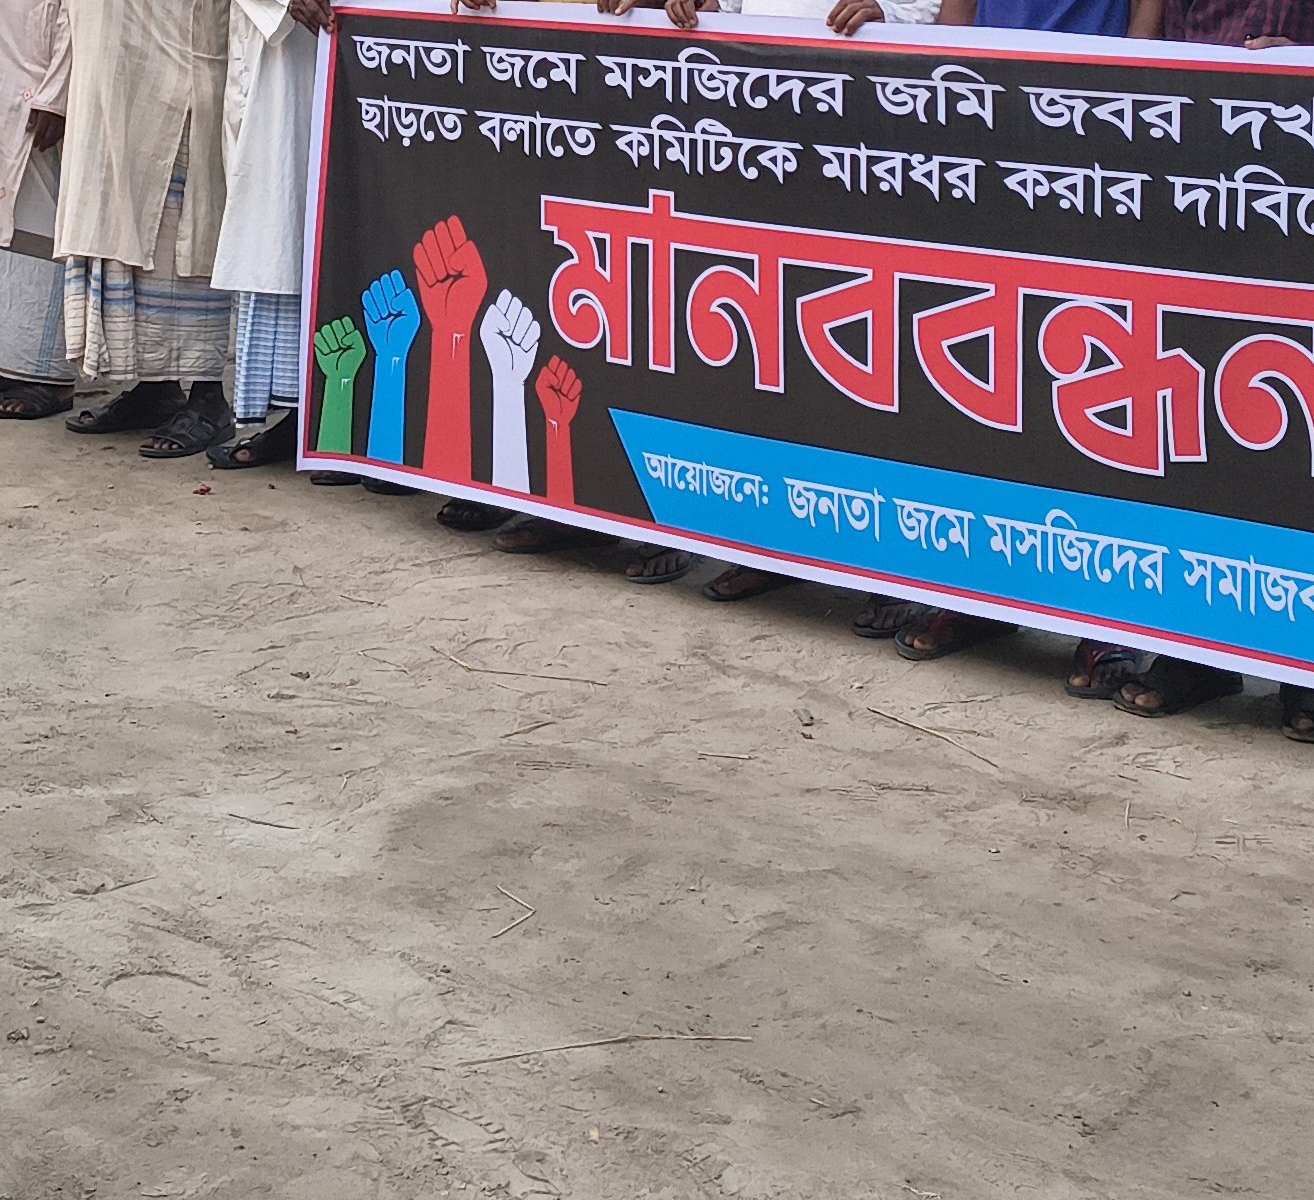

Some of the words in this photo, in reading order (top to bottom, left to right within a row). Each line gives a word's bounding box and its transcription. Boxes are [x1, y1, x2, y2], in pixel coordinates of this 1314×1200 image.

[351, 36, 471, 84] জনতা
[480, 46, 586, 93] জমে
[596, 46, 855, 117] মসজিদের
[867, 64, 1007, 130] জমি
[1019, 85, 1194, 143] জবর
[357, 95, 467, 147] ছাড়তে
[475, 111, 602, 158] বলাতে
[610, 113, 804, 184] কমিটিকে
[812, 141, 986, 204] মারধর
[995, 161, 1153, 220] করার
[642, 451, 769, 508] আয়োজনে:
[783, 476, 886, 542] জনতা
[892, 497, 976, 559] জমে
[983, 508, 1170, 595] মসজিদের
